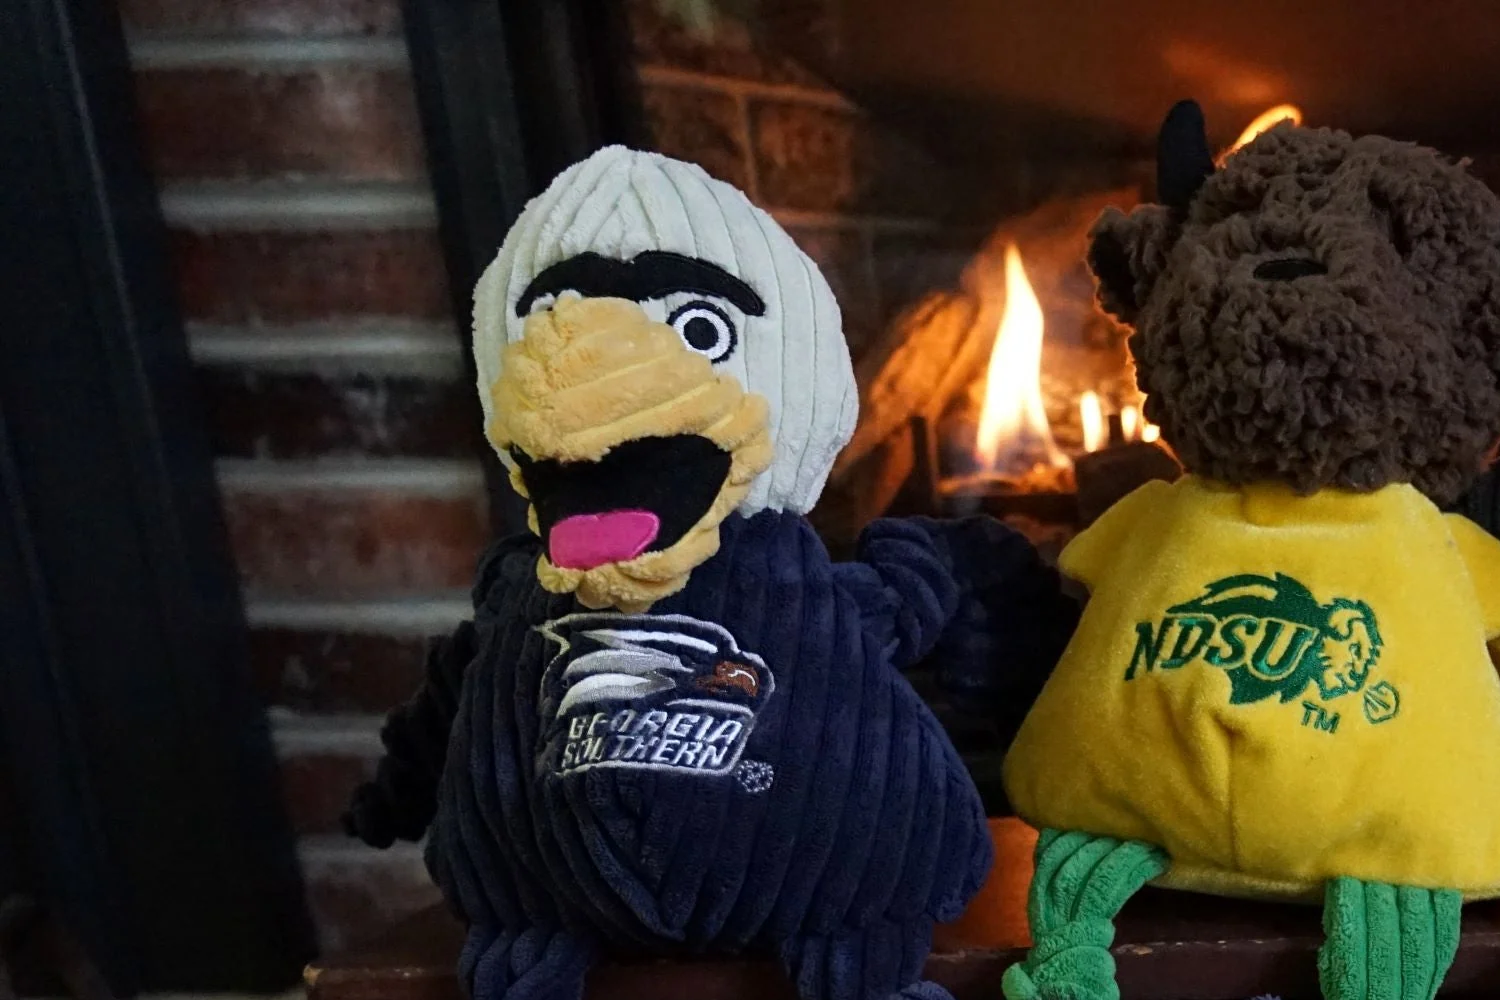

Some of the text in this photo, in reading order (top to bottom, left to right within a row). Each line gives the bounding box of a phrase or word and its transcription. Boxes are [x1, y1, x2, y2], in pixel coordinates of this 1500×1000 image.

[1124, 615, 1319, 682] NDSU
[1301, 700, 1340, 734] TM
[562, 735, 728, 768] SOUTHERN
